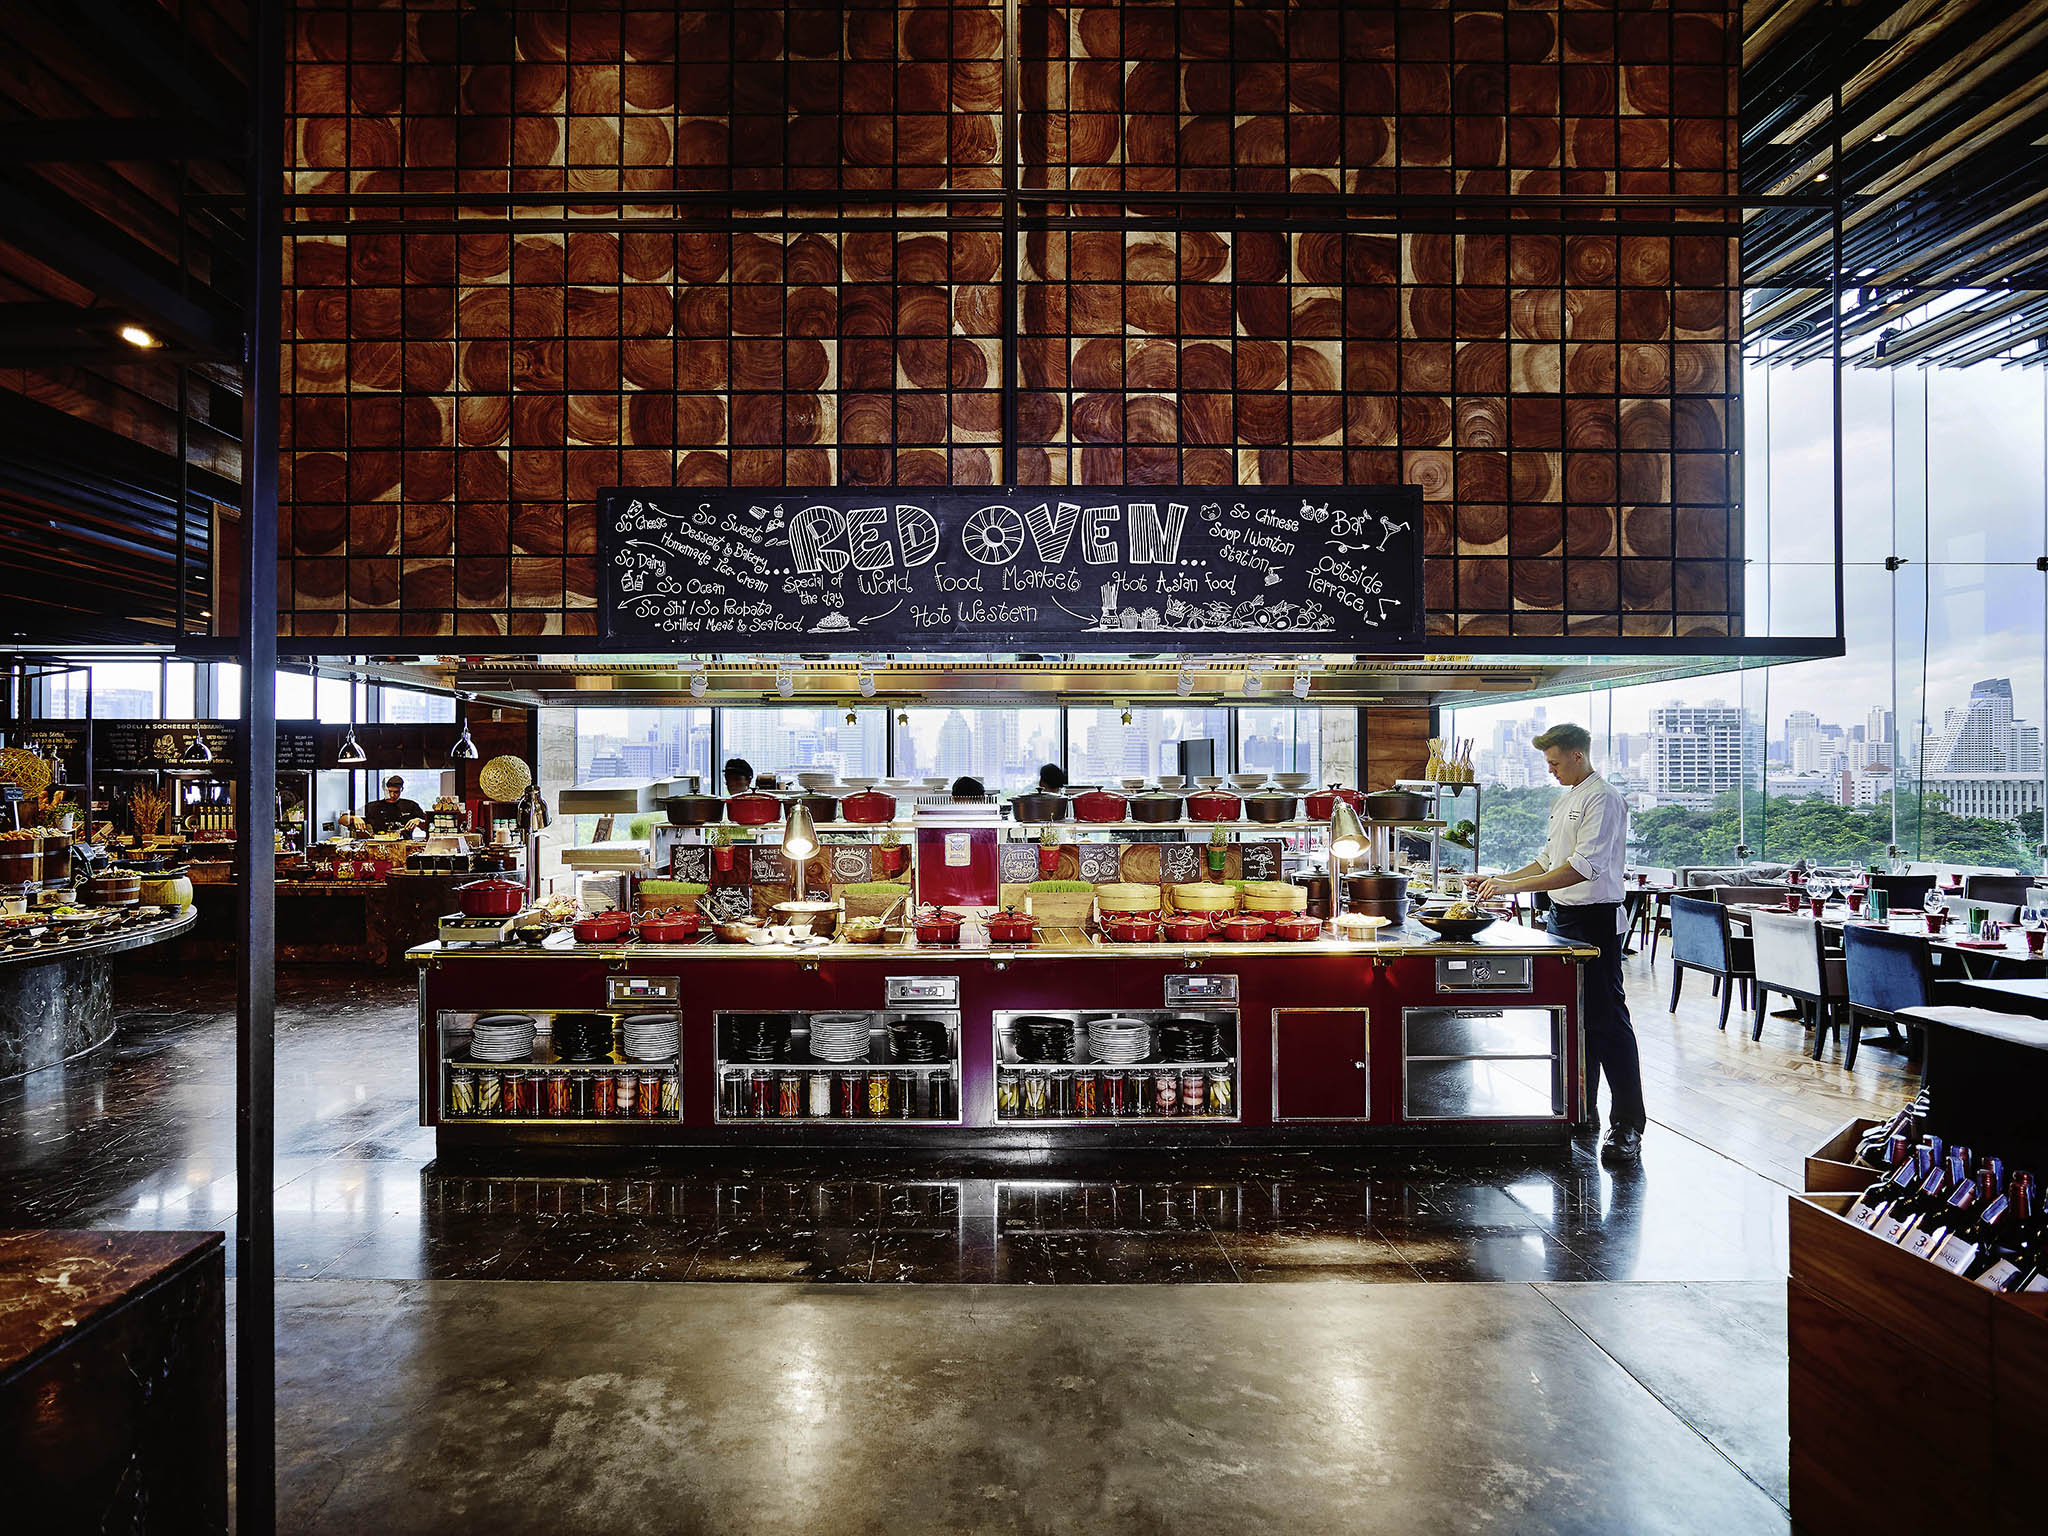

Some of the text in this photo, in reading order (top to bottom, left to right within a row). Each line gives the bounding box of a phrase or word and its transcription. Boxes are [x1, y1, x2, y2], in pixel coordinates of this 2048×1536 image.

[616, 514, 667, 532] So Cheese
[692, 504, 763, 544] So Sweet
[1230, 503, 1300, 532] So Chinese
[1330, 510, 1366, 536] Bar
[1209, 521, 1241, 545] Soup
[661, 532, 711, 566] Homemade
[680, 522, 768, 574] Dessert & Bakery
[1219, 544, 1270, 573] Station
[615, 549, 667, 577] So Dairy
[1319, 556, 1383, 594] Outside
[657, 576, 725, 595] So Ocean
[782, 572, 844, 594] Special of
[857, 569, 913, 595] World
[1002, 565, 1081, 592] Market
[1112, 570, 1148, 592] Hot
[1155, 570, 1198, 593] Asian
[1306, 567, 1365, 612] Terrace
[635, 599, 660, 617] So
[663, 600, 685, 616] Shi
[723, 599, 772, 617] Robata
[799, 590, 845, 608] the day
[910, 599, 1038, 627] Hot Western
[662, 614, 804, 633] Grilled Meat & Seafood
